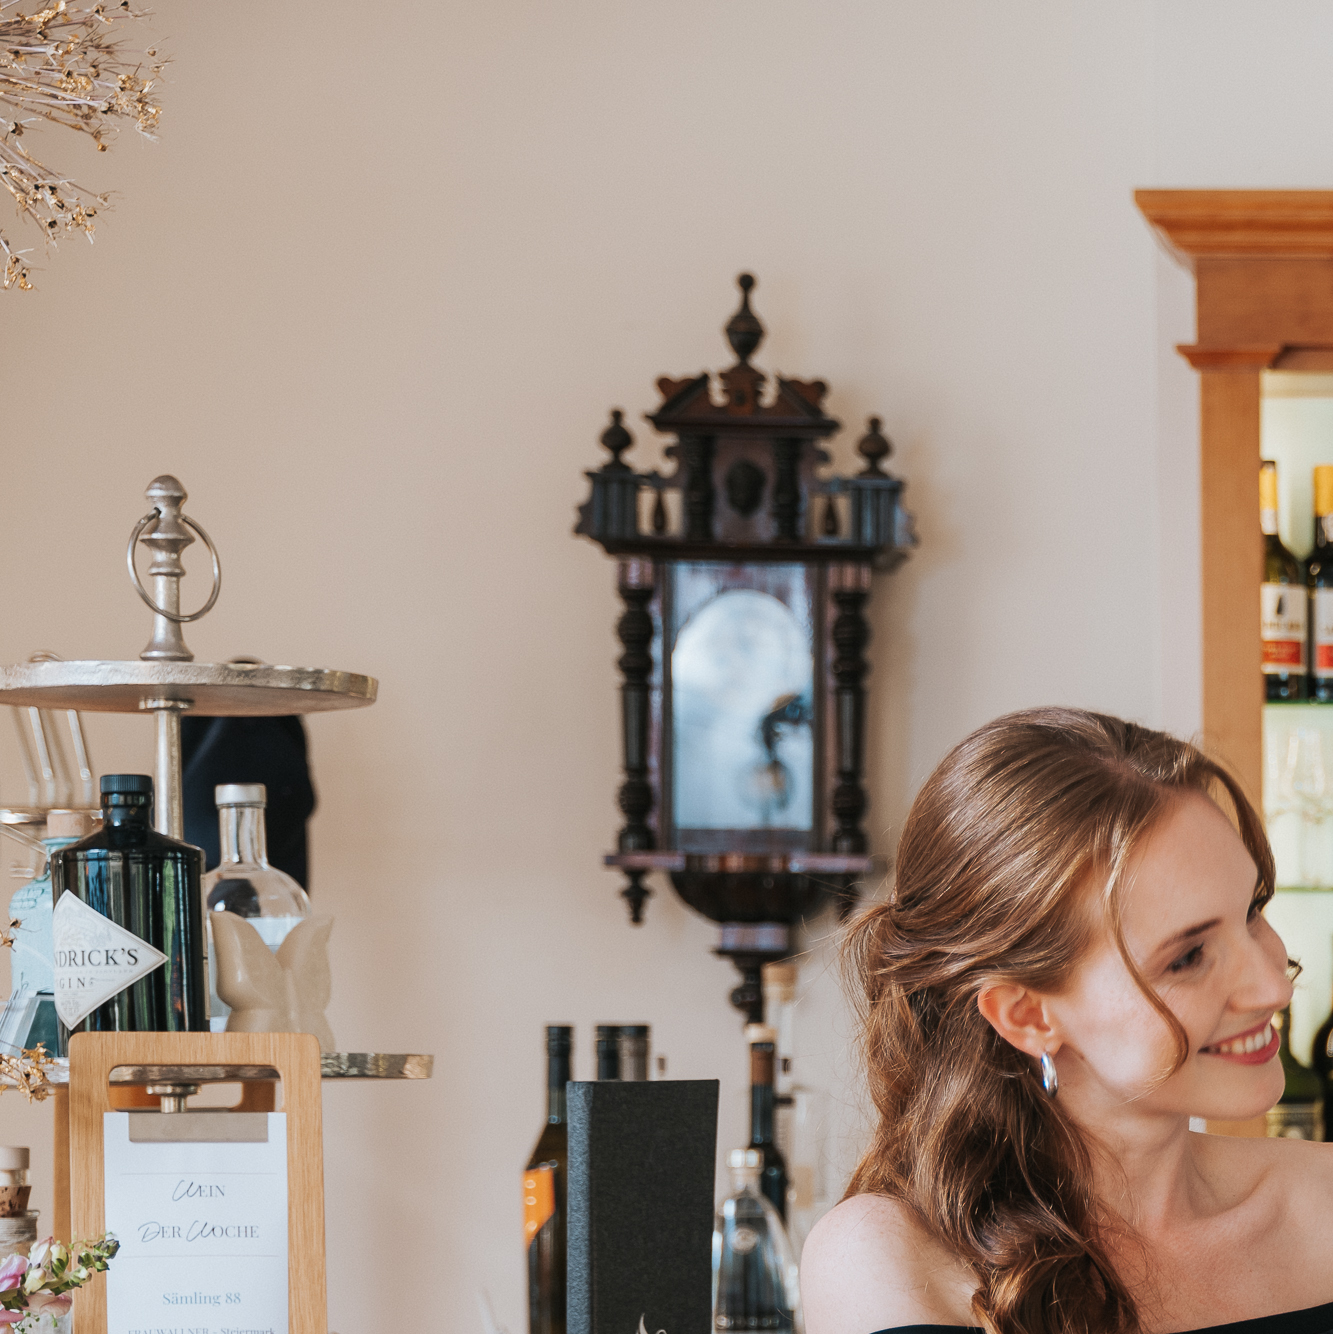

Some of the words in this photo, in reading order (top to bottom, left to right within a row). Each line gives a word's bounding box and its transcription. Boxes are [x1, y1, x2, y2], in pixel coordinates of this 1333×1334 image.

[59, 977, 86, 990] GIN
[138, 1221, 182, 1243] DER
[186, 1220, 260, 1242] WOCHE
[162, 1291, 221, 1306] Sämling
[225, 1292, 242, 1305] 88
